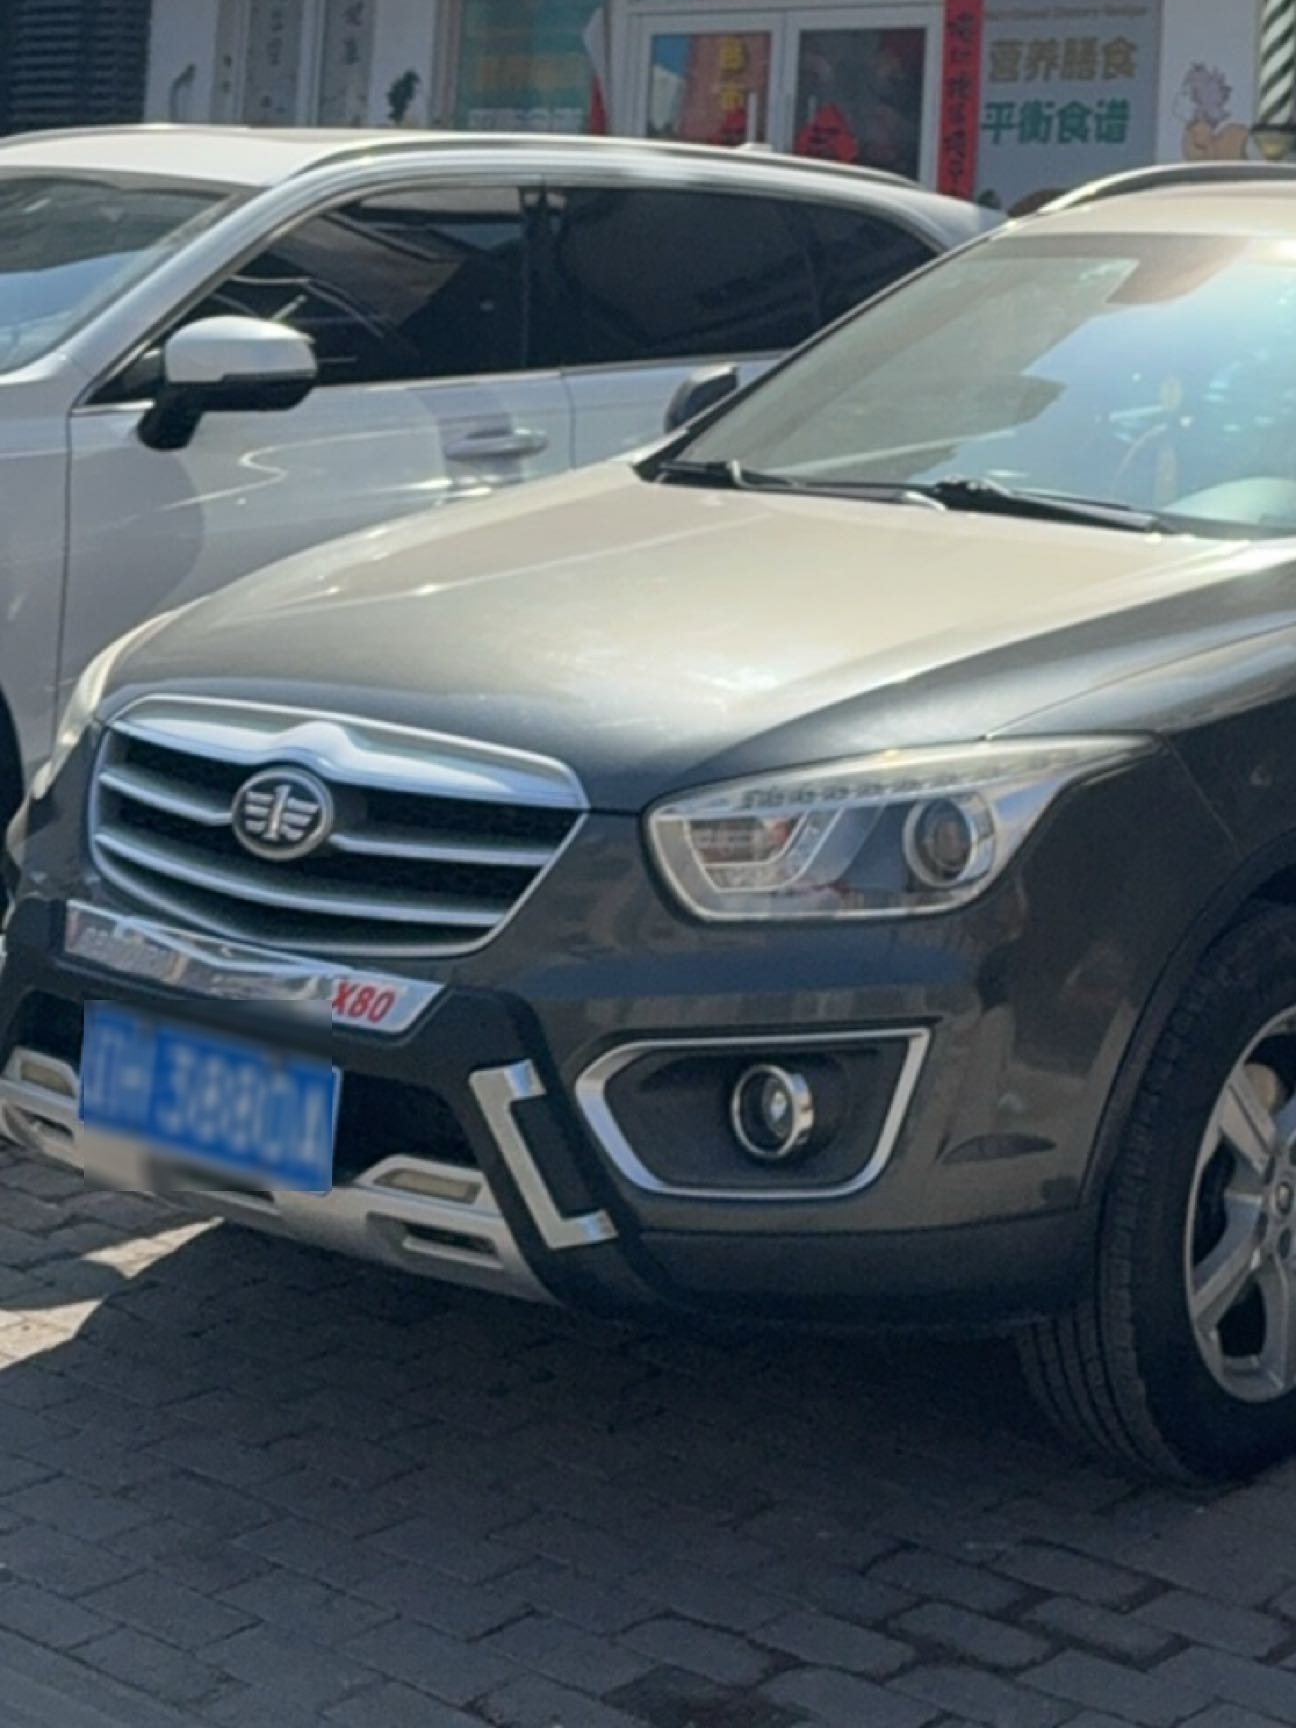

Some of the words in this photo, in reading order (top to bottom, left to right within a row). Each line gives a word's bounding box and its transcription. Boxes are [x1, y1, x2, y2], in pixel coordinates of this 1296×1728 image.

[988, 35, 1138, 83] 营养膳食
[981, 98, 1130, 145] 平衡食谱
[331, 980, 396, 1024] X80
